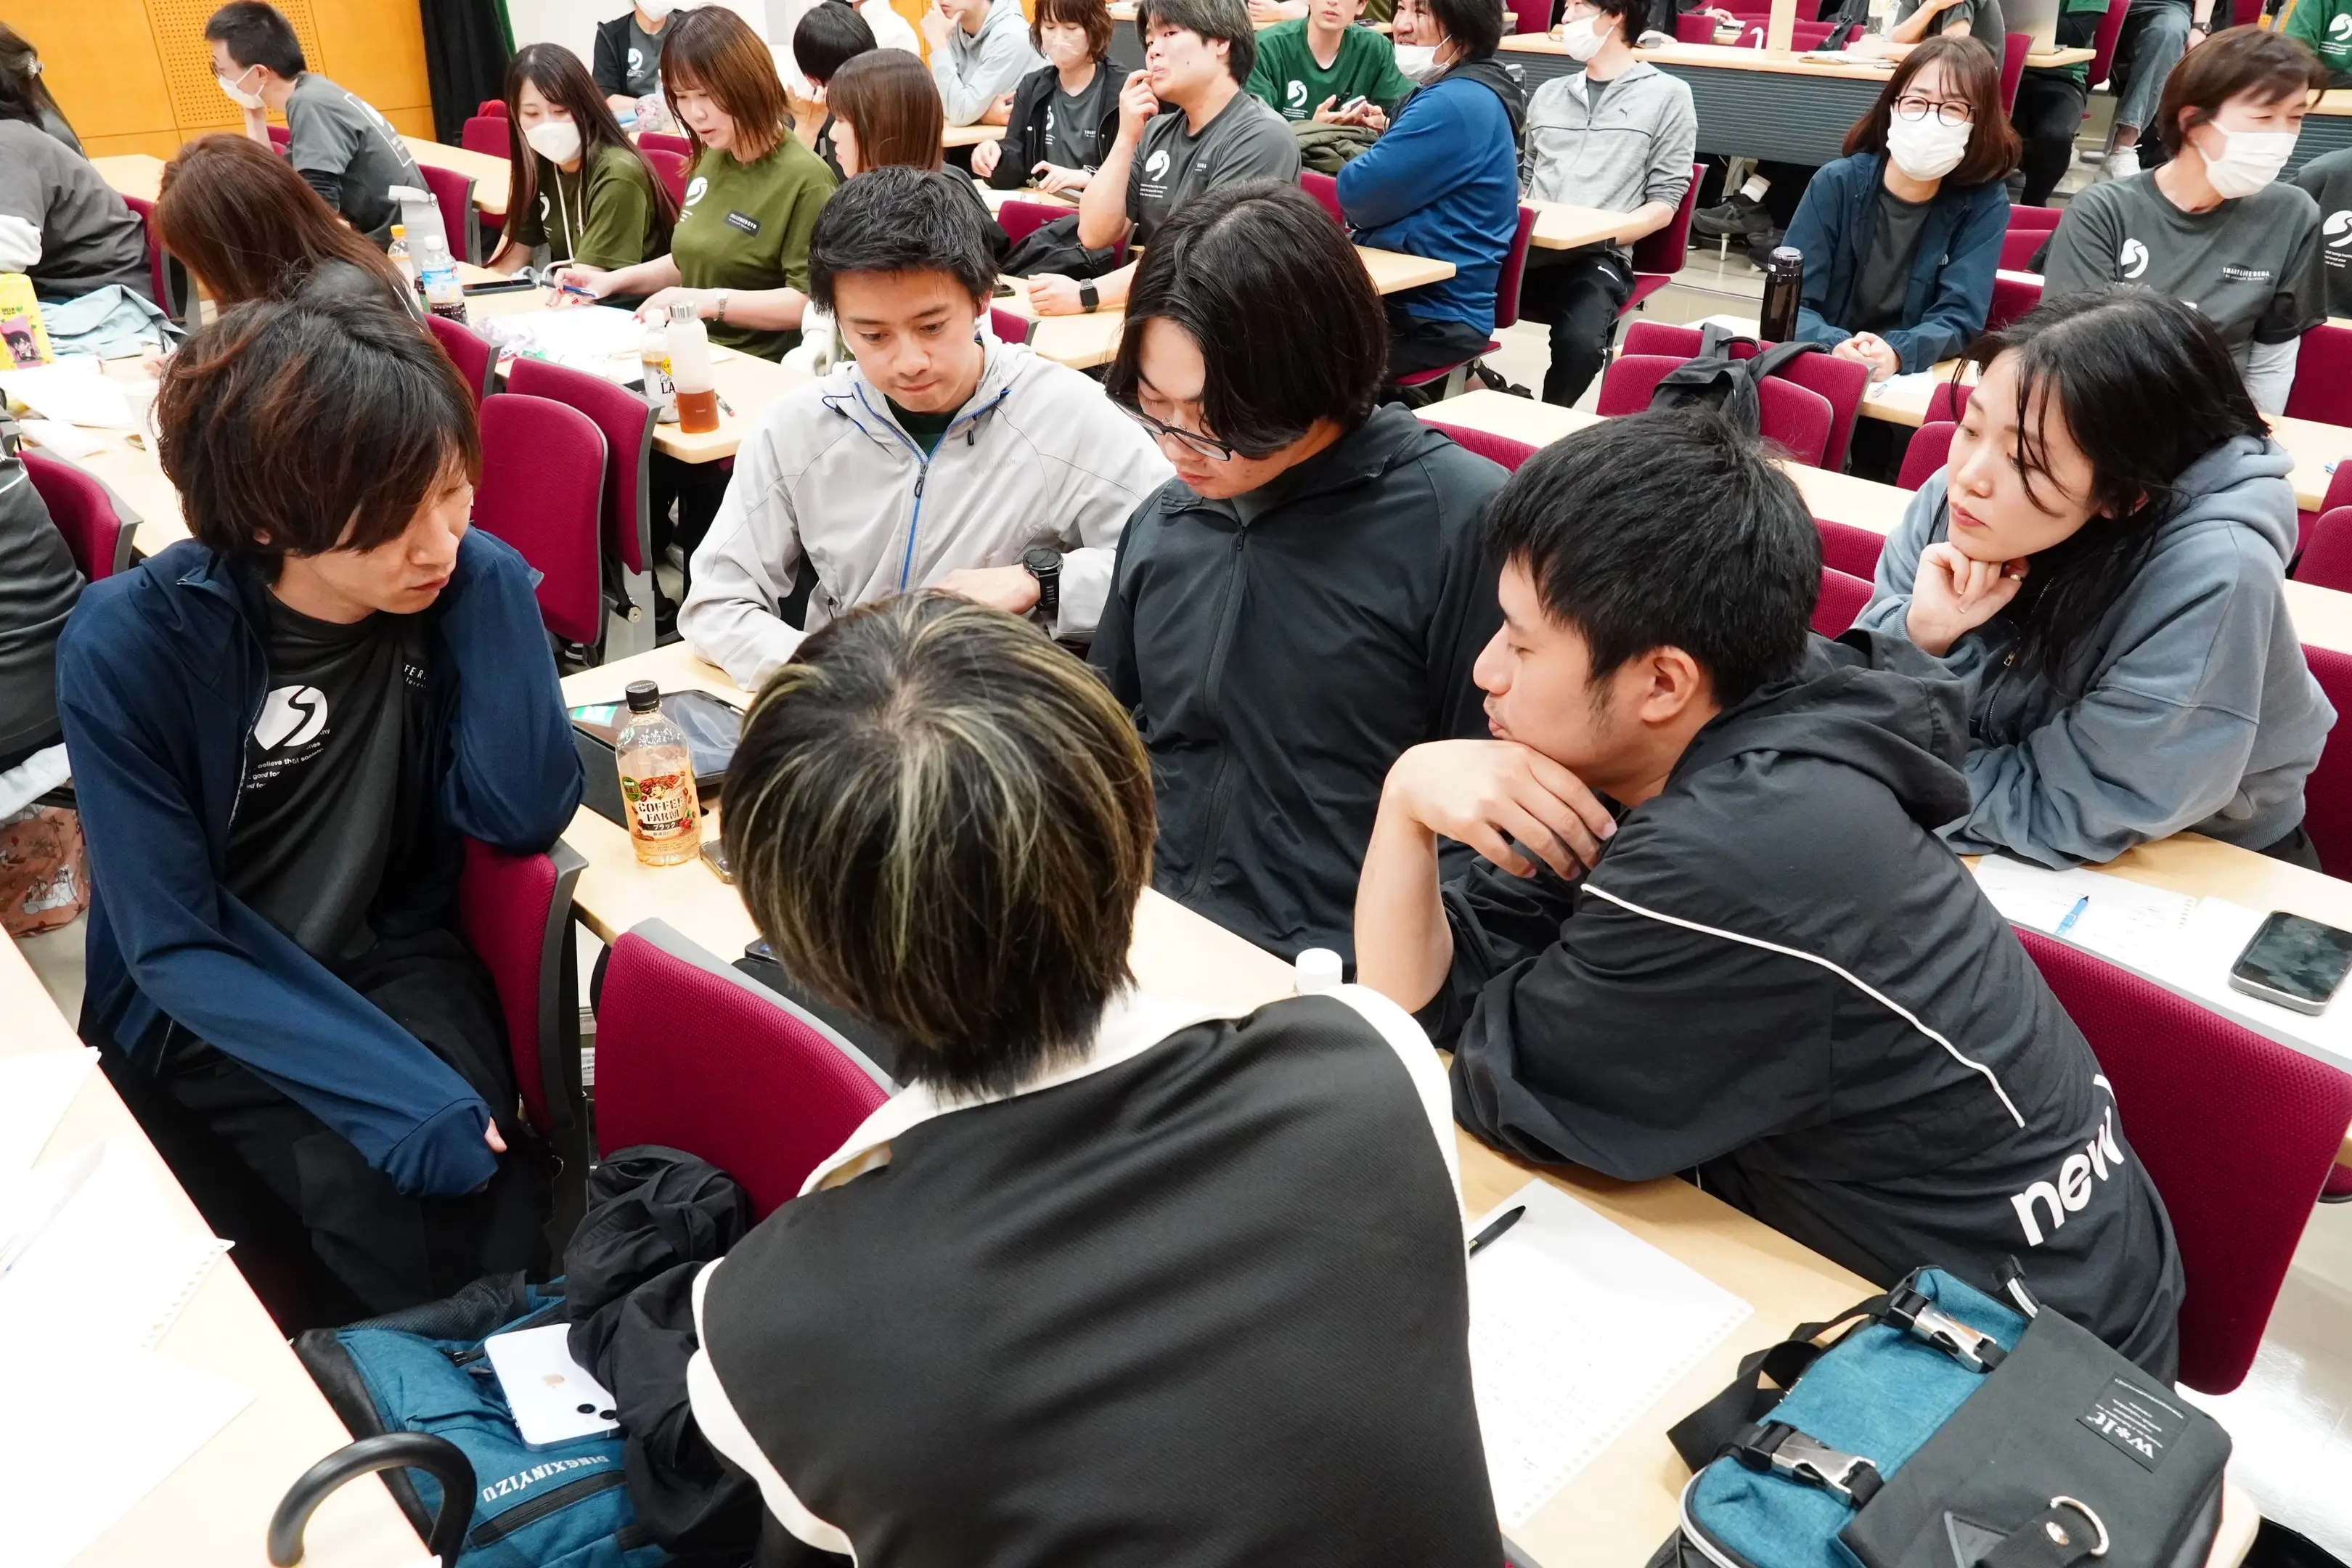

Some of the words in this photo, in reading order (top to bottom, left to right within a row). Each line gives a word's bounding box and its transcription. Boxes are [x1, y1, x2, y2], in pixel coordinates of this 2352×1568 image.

[638, 796, 685, 812] COFFEE
[647, 809, 680, 822] FARM
[653, 822, 676, 830] ブラック
